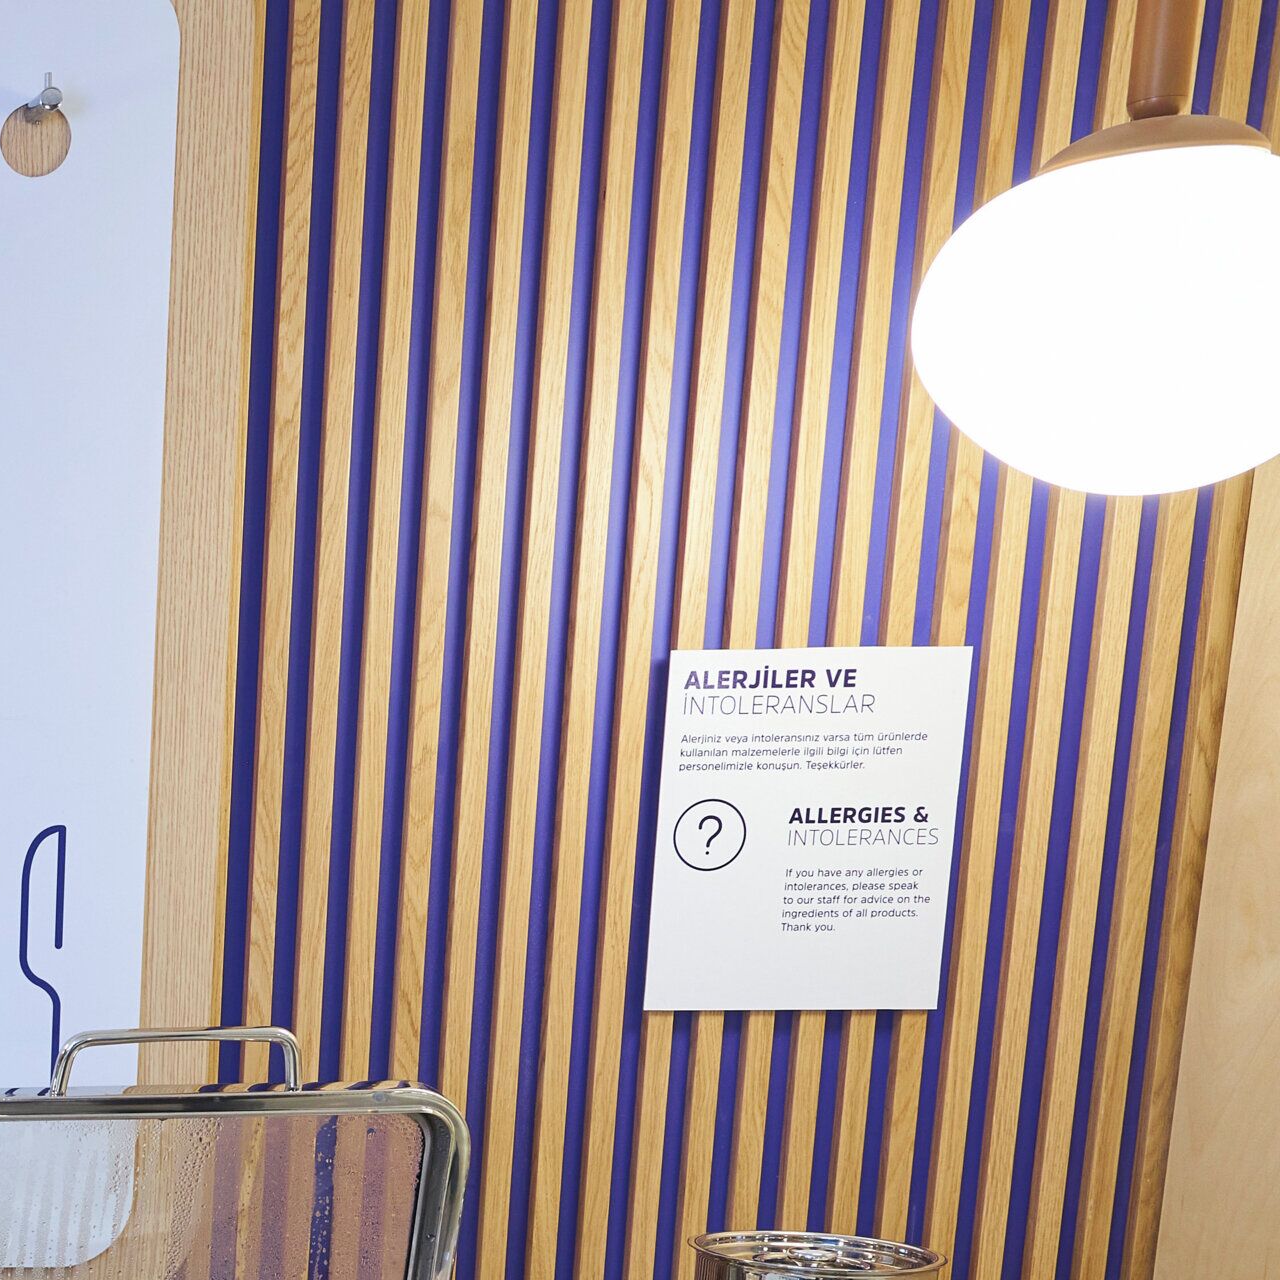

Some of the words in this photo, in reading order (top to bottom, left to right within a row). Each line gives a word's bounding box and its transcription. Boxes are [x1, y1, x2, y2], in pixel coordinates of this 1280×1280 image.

[684, 666, 816, 689] ALERJİLER
[826, 668, 857, 688] VE
[683, 693, 876, 715] İNTOLERANSLAR
[681, 734, 722, 744] Alerjiniz
[725, 735, 748, 743] veya
[823, 734, 850, 742] varsa
[854, 733, 874, 741] tüm
[878, 732, 928, 741] ürünlerde
[732, 747, 800, 756] malzemelerle
[803, 747, 824, 757] ilgili
[827, 746, 848, 757] bilgi
[852, 747, 869, 757] için
[873, 746, 903, 755] lütfen
[679, 762, 753, 771] personelimizle
[756, 761, 802, 771] konuşun.
[789, 807, 906, 823] ALLERGIES
[913, 806, 929, 823] &
[788, 828, 939, 846] INTOLERANCES
[785, 869, 793, 877] If
[796, 870, 814, 878] you
[818, 869, 841, 877] have
[845, 870, 863, 878] any
[867, 868, 909, 878] allergies
[784, 883, 849, 891] intolerances,
[852, 882, 885, 891] please
[889, 882, 919, 891] speak
[818, 896, 840, 904] staff
[843, 896, 857, 904] for
[861, 896, 893, 904] advice
[897, 896, 910, 904] on
[913, 895, 930, 904] the
[782, 910, 839, 919] ingredients
[842, 909, 853, 917] of
[856, 909, 867, 917] all
[871, 909, 919, 918] products.
[782, 923, 811, 931] Thank
[814, 924, 835, 932] you.
